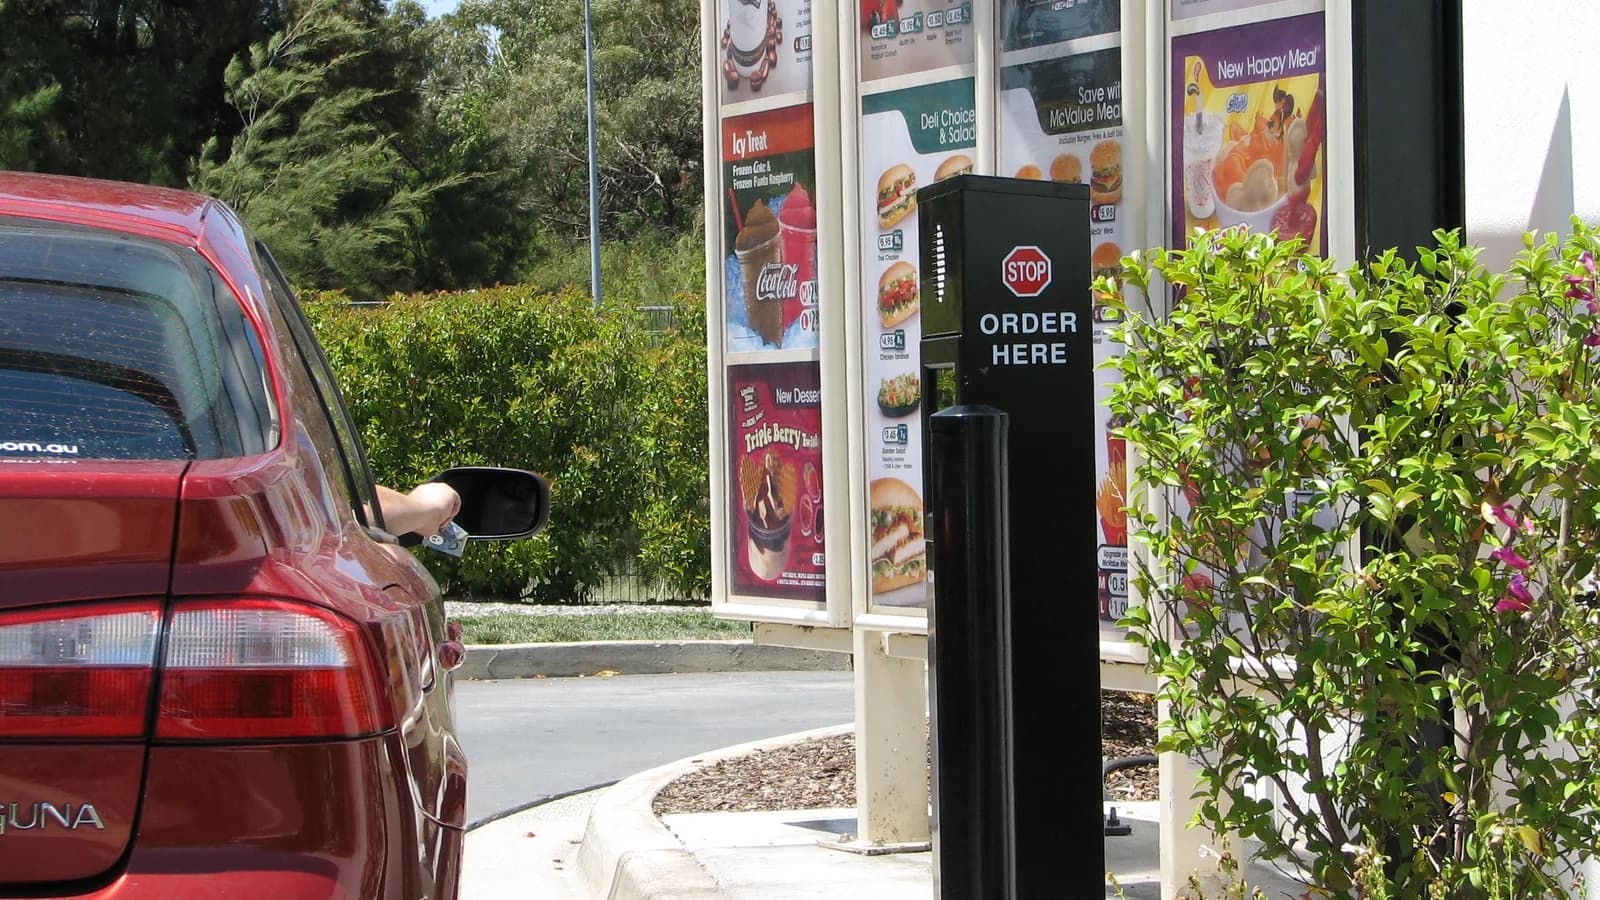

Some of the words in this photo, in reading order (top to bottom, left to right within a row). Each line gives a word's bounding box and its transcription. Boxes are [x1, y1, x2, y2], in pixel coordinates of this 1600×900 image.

[1218, 60, 1244, 80] New
[1247, 54, 1286, 78] Happy
[1078, 86, 1104, 105] Save
[1107, 80, 1121, 100] wit
[921, 111, 939, 130] Deli
[1049, 107, 1094, 128] McValue
[1096, 102, 1120, 121] Mea
[732, 131, 746, 158] Icy
[746, 130, 768, 153] Treat
[939, 127, 946, 145] &
[732, 165, 753, 177] Frozen
[733, 178, 753, 190] Frozen
[753, 175, 769, 188] Fanta
[769, 172, 794, 186] Raspberry
[1008, 261, 1047, 282] STOP
[979, 312, 1077, 335] ORDER
[992, 343, 1067, 366] HERE
[776, 388, 792, 404] New
[793, 387, 820, 404] Desser
[0, 442, 78, 453] om.au
[744, 422, 773, 453] Triple
[773, 423, 801, 451] Berry
[1103, 550, 1121, 559] Upgrade
[1098, 576, 1106, 590] M
[1109, 599, 1128, 616] $1.0
[0, 803, 105, 834] UNA
